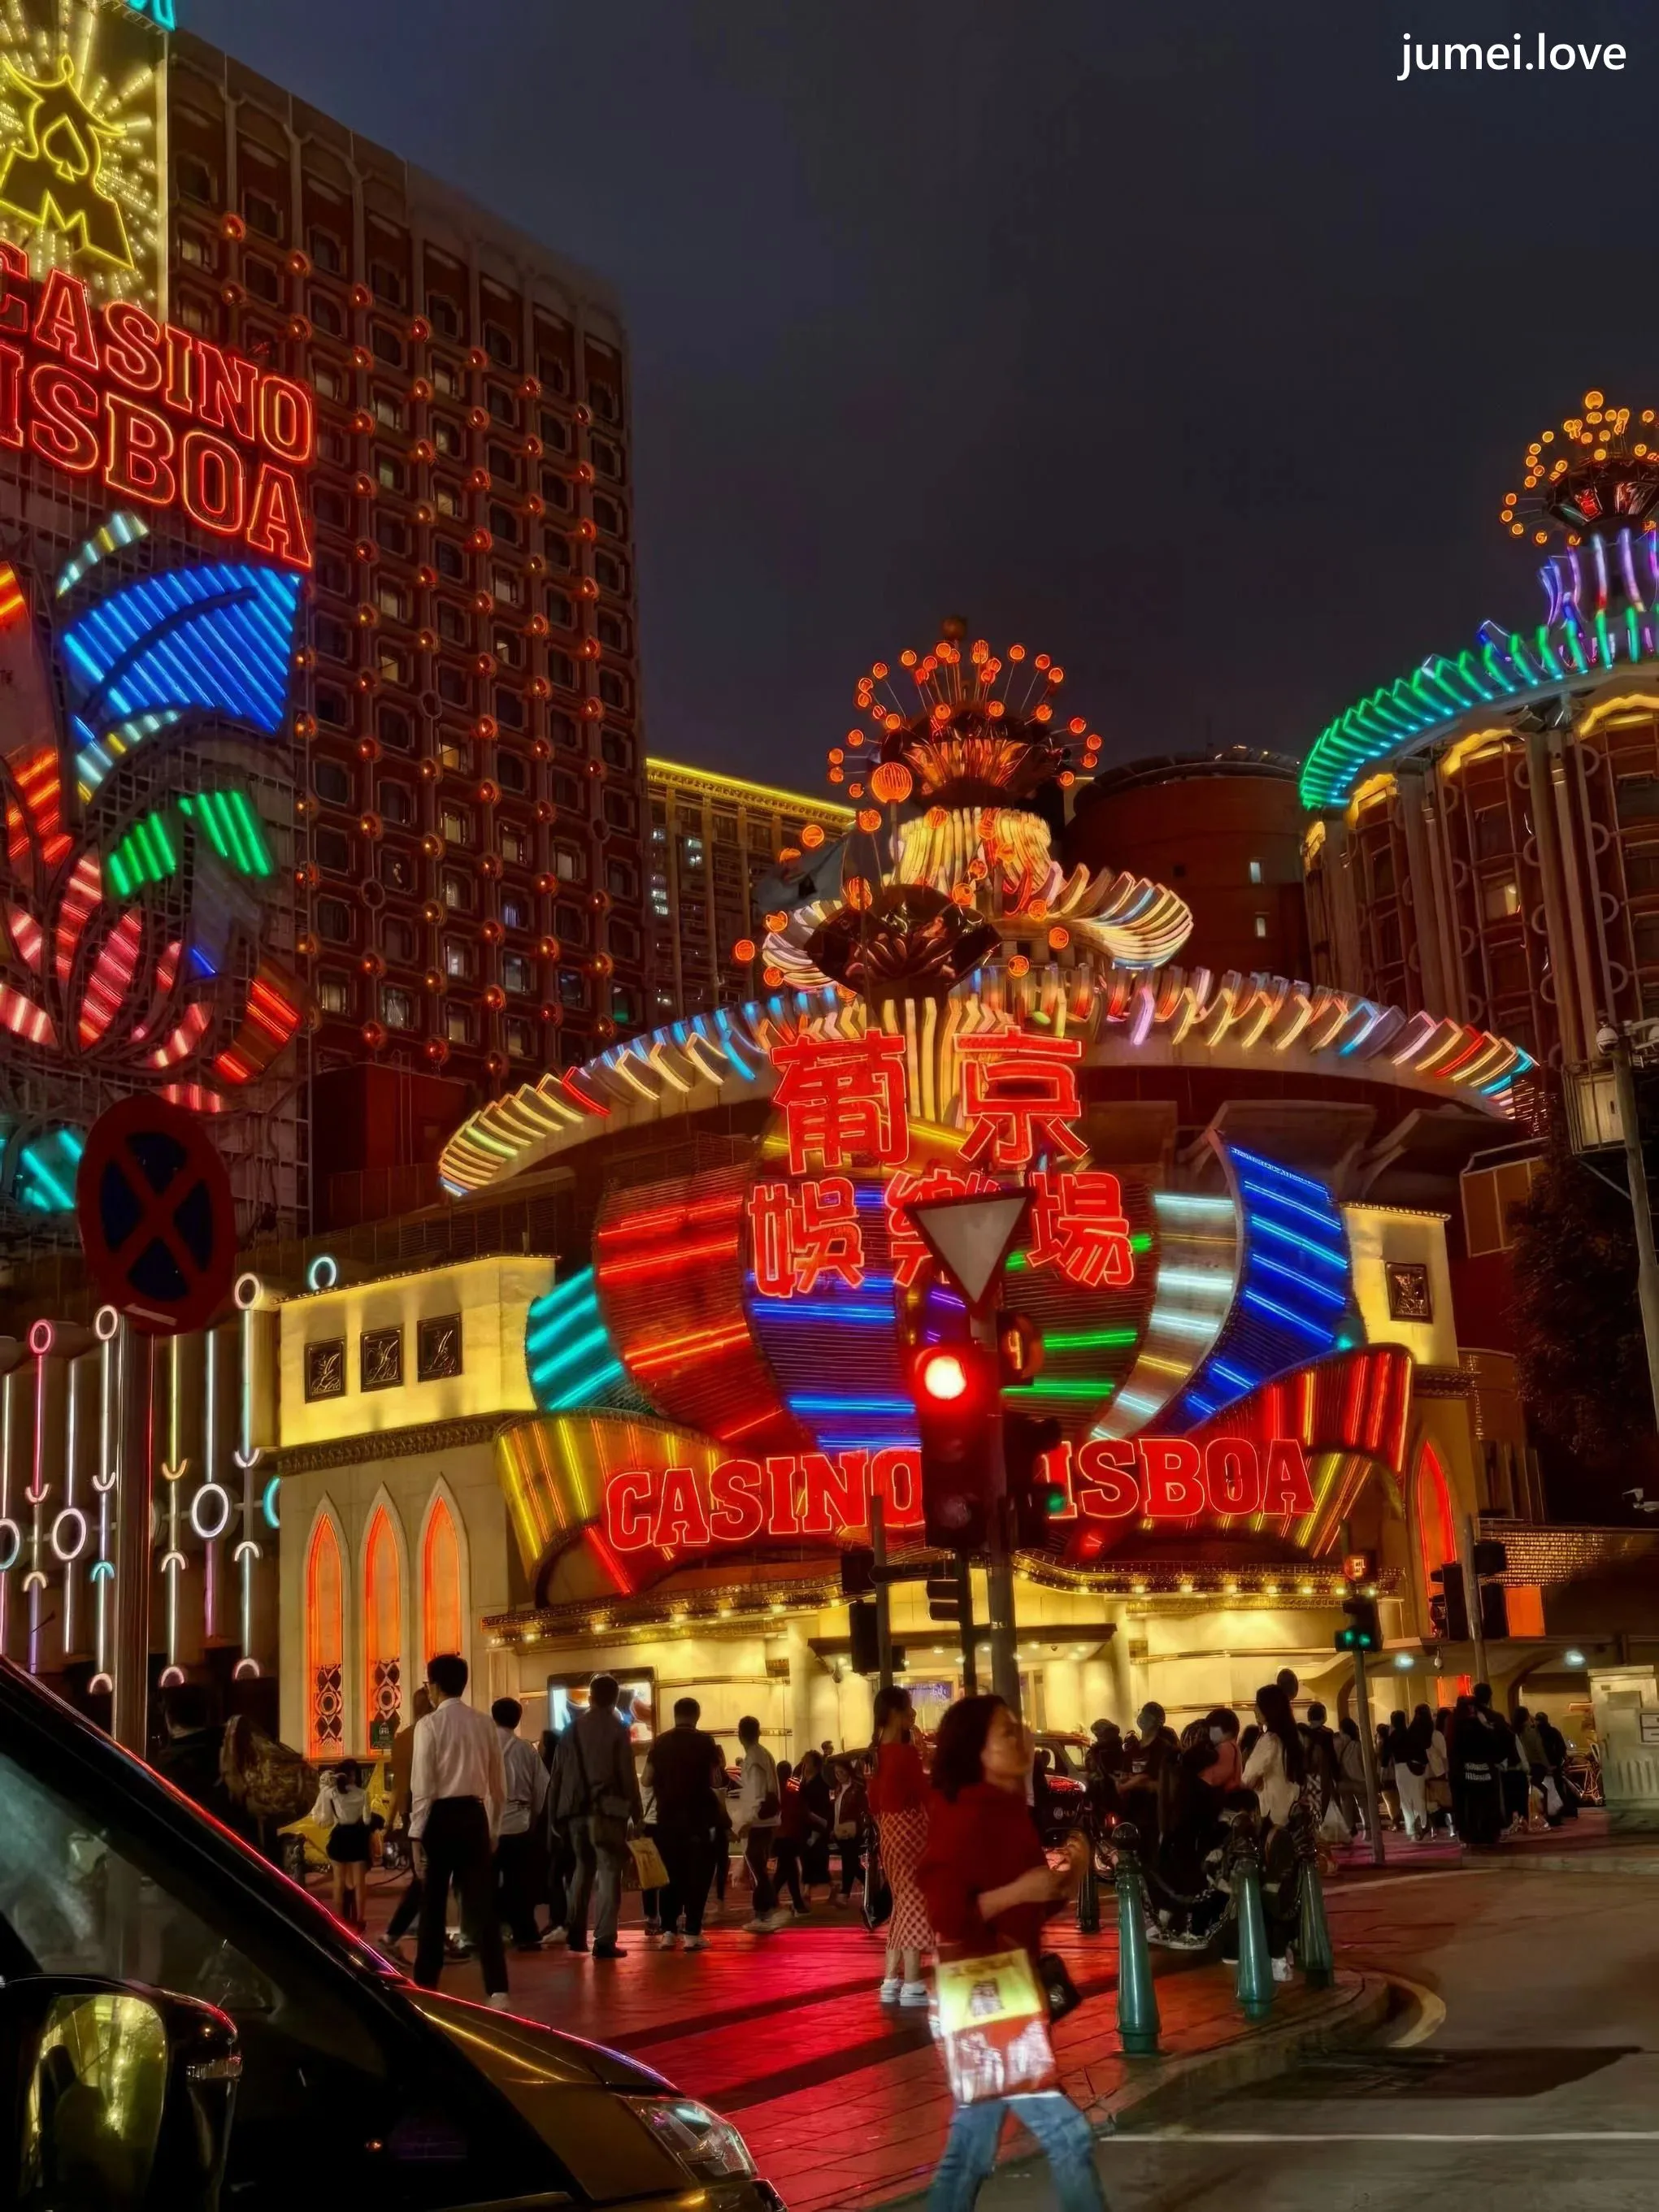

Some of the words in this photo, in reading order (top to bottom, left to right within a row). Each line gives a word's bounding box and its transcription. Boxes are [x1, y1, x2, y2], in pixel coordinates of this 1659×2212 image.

[770, 1026, 1091, 1175] 葡京
[606, 1446, 927, 1551] CASINO
[1041, 1438, 1317, 1520] ISBOA
